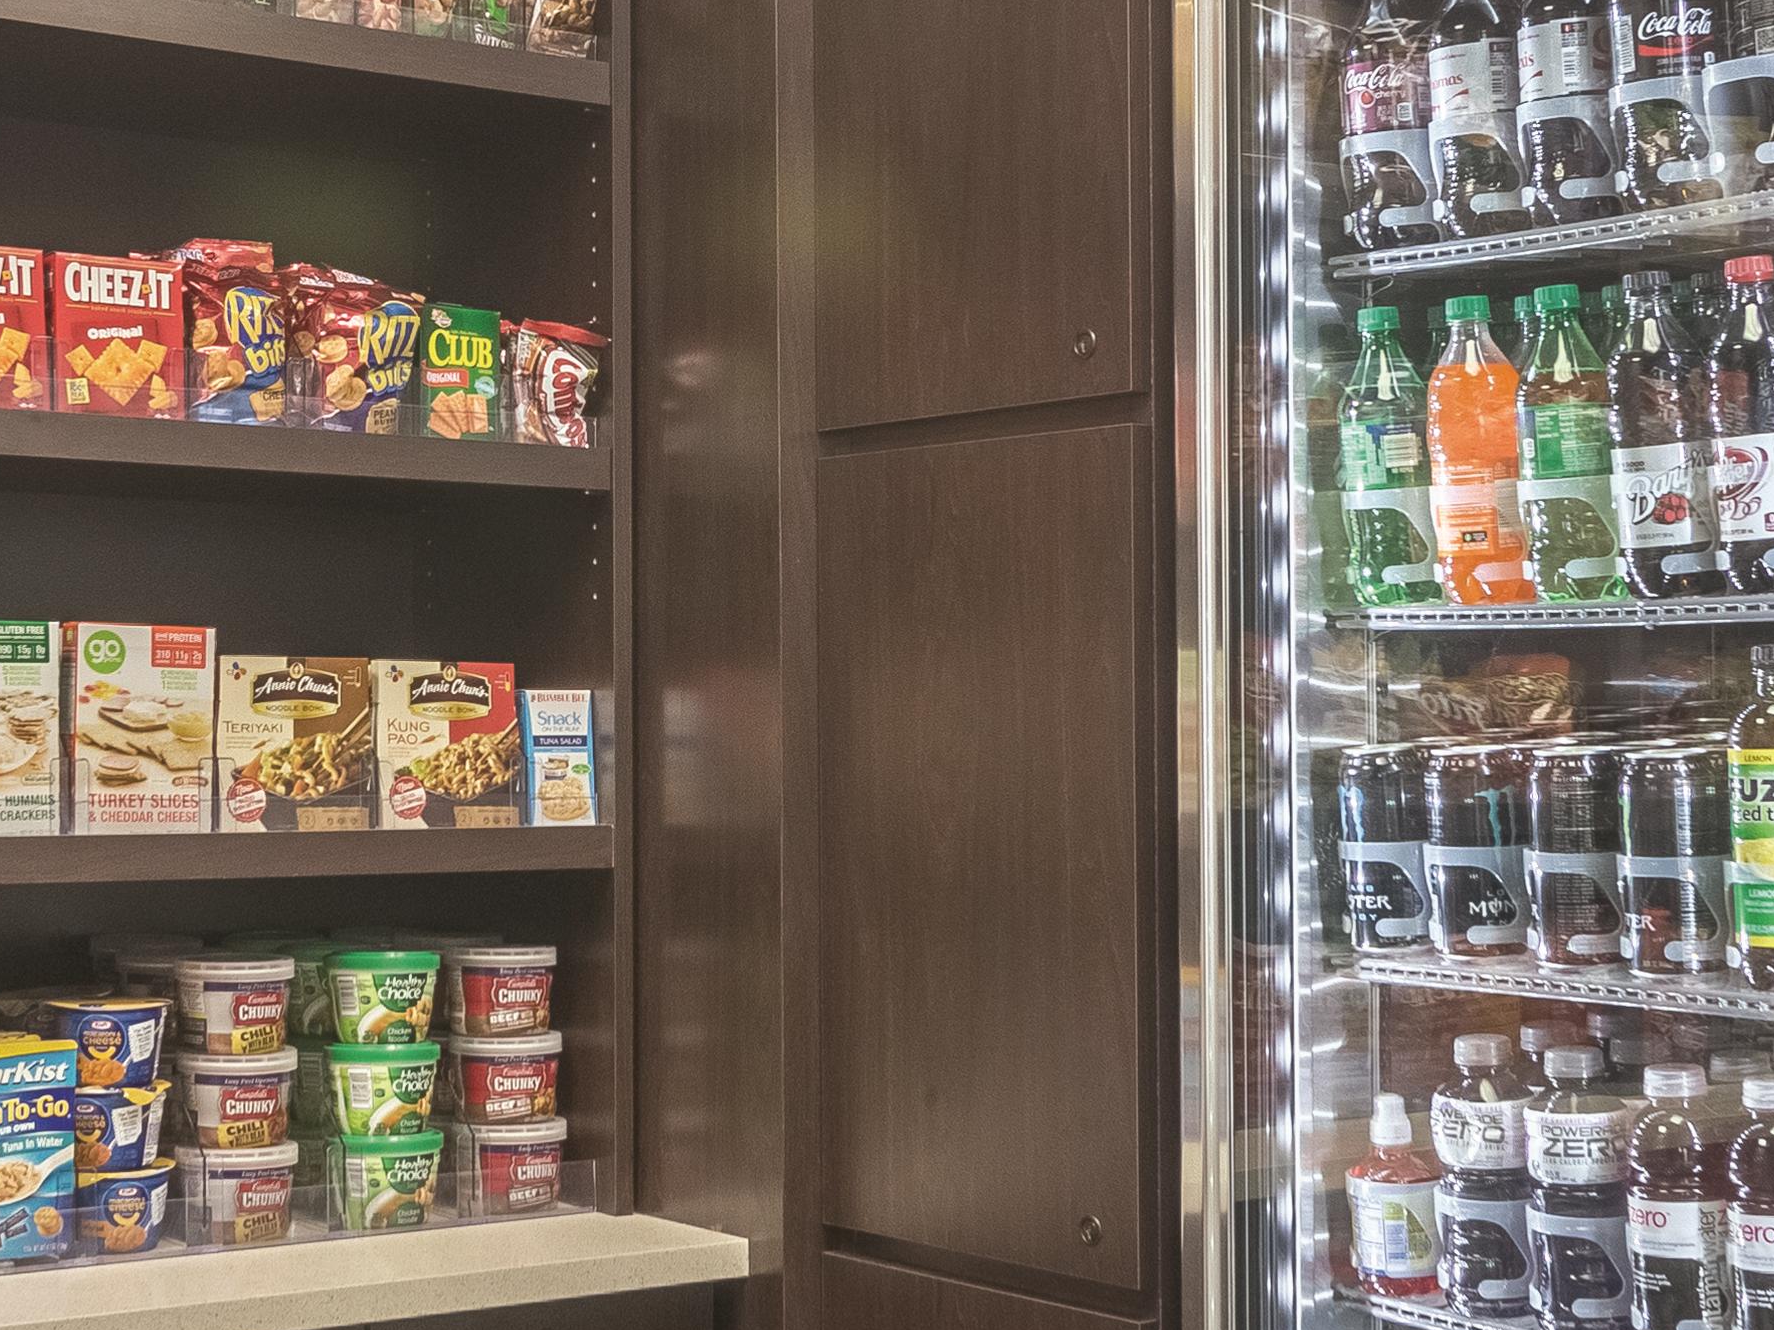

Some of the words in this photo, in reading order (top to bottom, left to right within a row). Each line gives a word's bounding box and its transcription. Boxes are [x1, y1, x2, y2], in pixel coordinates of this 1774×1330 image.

[1638, 6, 1714, 42] Coca-Cola
[1344, 63, 1404, 90] Coca-Cola
[64, 262, 174, 309] CHEEZ-IT
[363, 311, 420, 364] RITZ
[429, 329, 493, 369] CLUB
[537, 710, 581, 726] Snack
[222, 720, 283, 734] TERIYAKI
[387, 719, 430, 733] KUNG
[388, 733, 419, 745] PAO
[1744, 754, 1772, 763] LEMON
[6, 793, 55, 808] HUMMUS
[89, 794, 145, 809] TURKEY
[150, 794, 199, 809] SLICES
[0, 809, 55, 822] CRACKERS
[89, 812, 97, 822] &
[100, 811, 154, 823] CHEDDAR
[158, 811, 199, 822] CHEESE
[498, 988, 543, 1003] CHUNKY
[494, 1076, 541, 1091] CHUNKY
[226, 1099, 276, 1115] CHUNKY
[1630, 1207, 1667, 1228] zero
